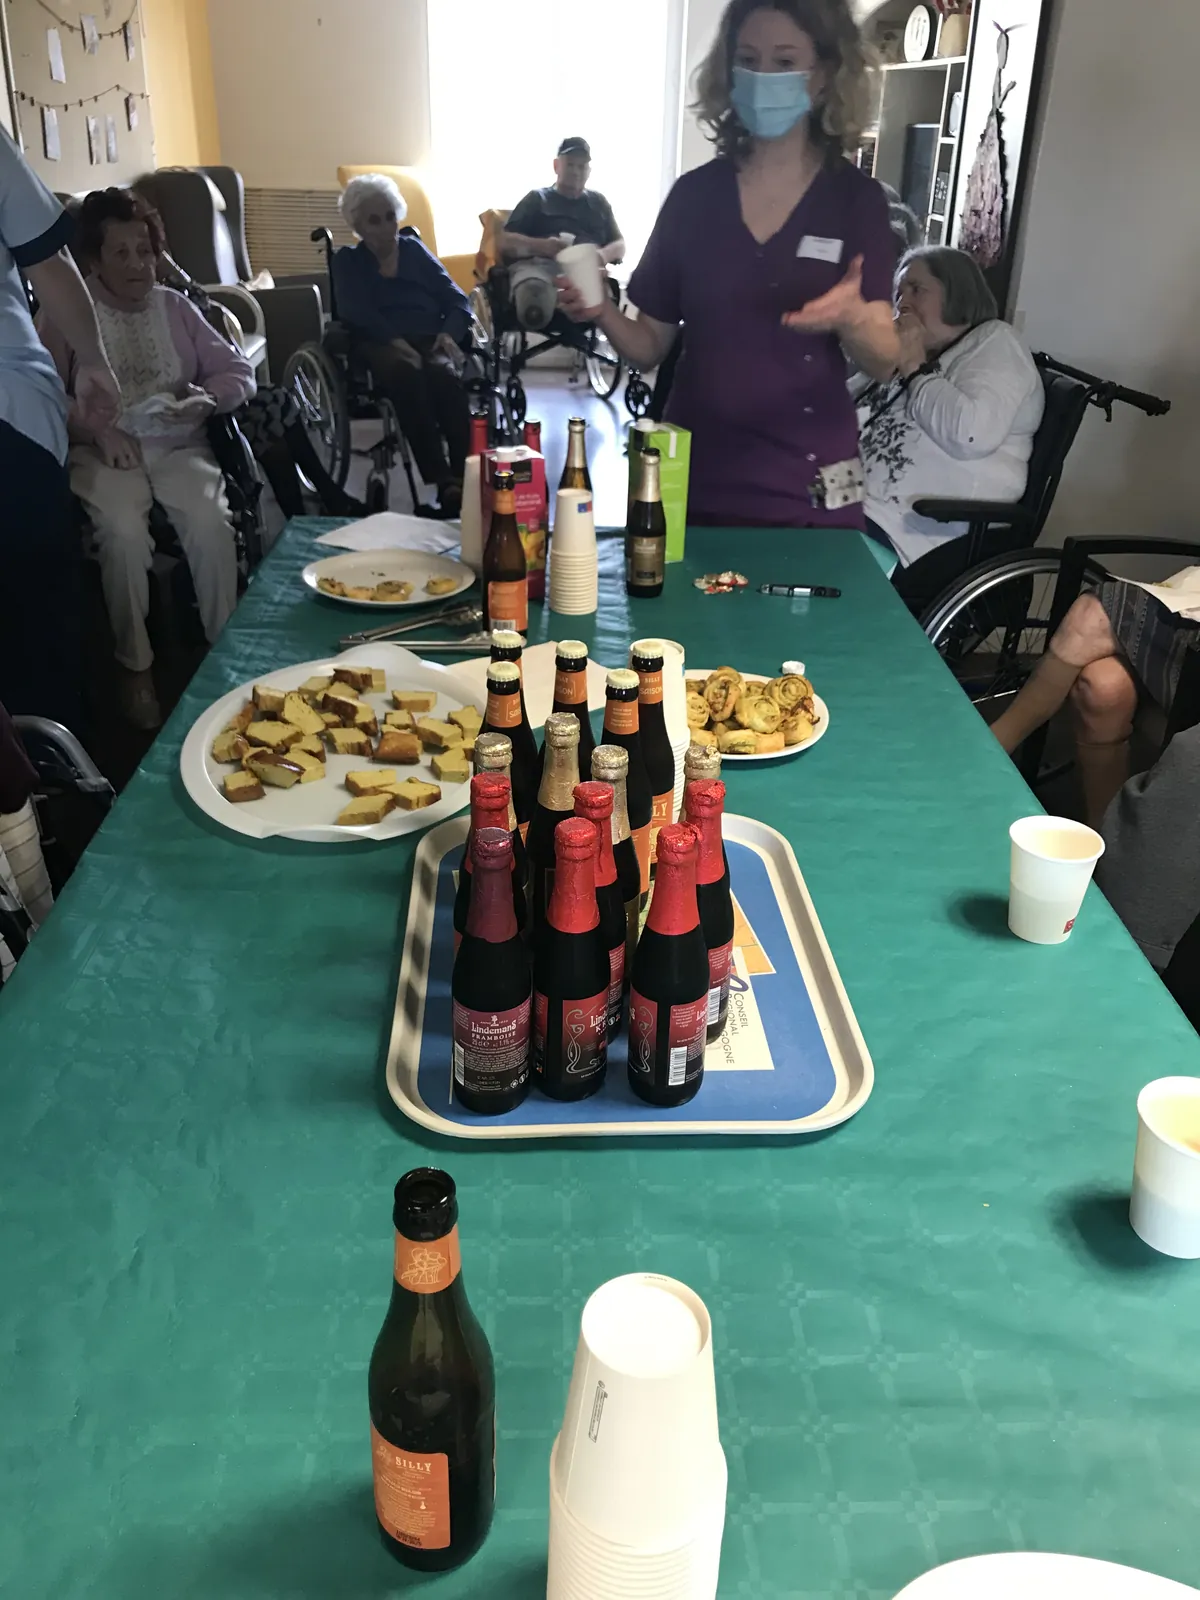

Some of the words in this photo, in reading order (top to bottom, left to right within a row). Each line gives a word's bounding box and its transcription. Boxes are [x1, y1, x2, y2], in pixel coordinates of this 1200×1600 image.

[733, 992, 749, 1028] CONSEIL
[471, 1030, 517, 1041] FRAMBOISE
[395, 1456, 432, 1472] SILLY
